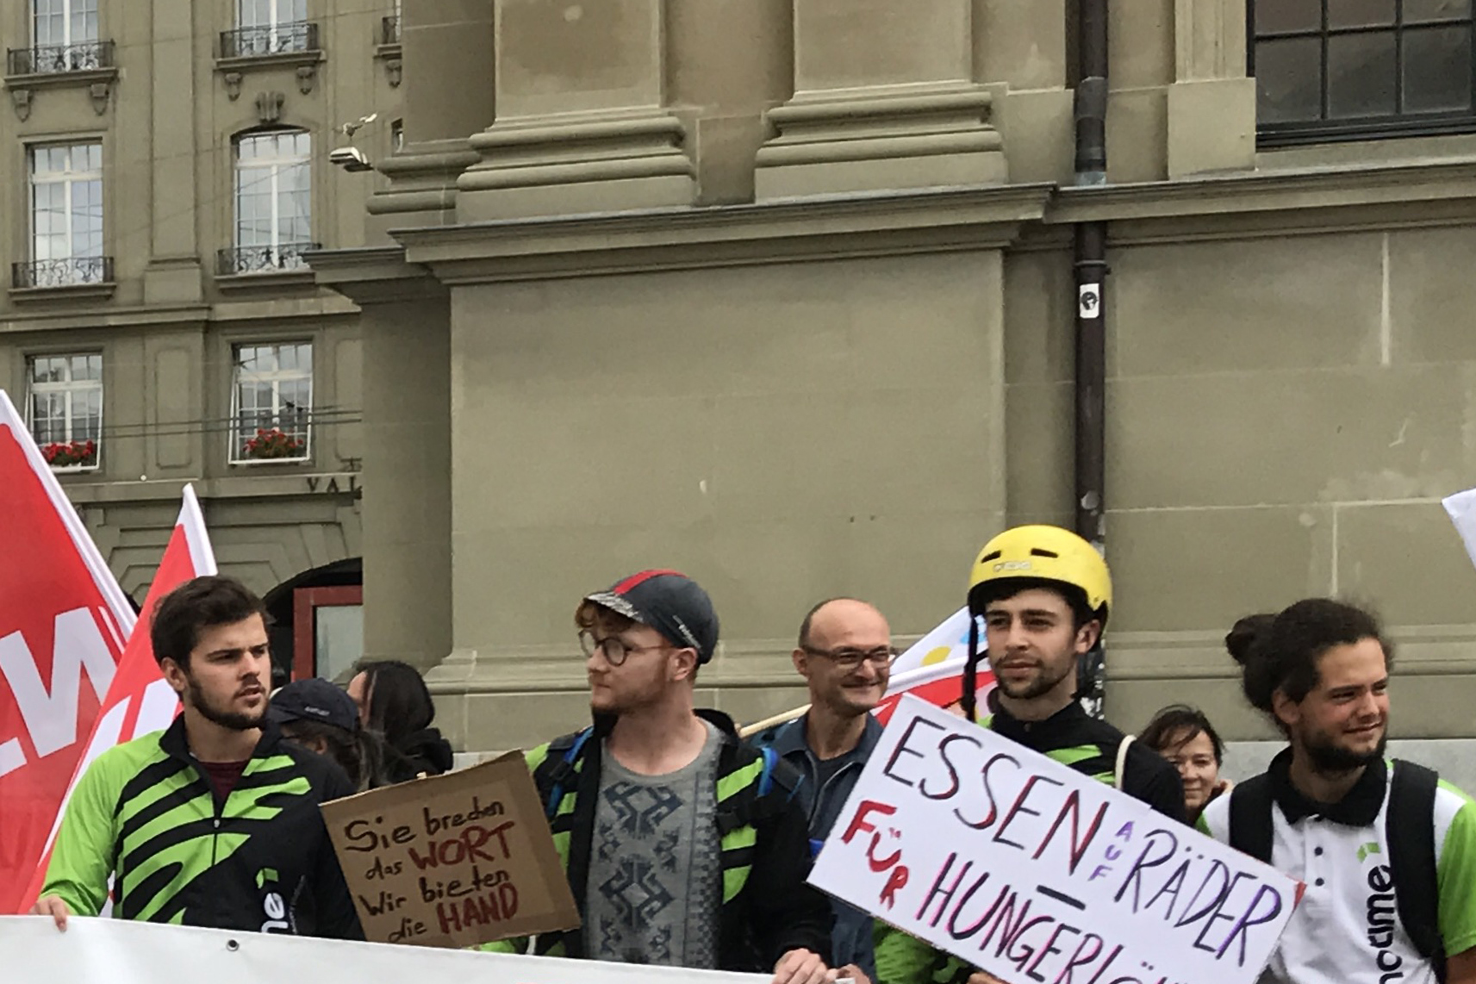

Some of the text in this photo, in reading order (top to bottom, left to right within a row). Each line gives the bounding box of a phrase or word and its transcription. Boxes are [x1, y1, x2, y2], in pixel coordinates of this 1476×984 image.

[344, 815, 416, 852] Sie
[365, 820, 516, 881] das WORT
[840, 799, 911, 912] FÜR
[882, 714, 1282, 968] ESSEN AUF RÄDER
[357, 864, 510, 917] Wir bieten
[387, 881, 519, 943] die HAND
